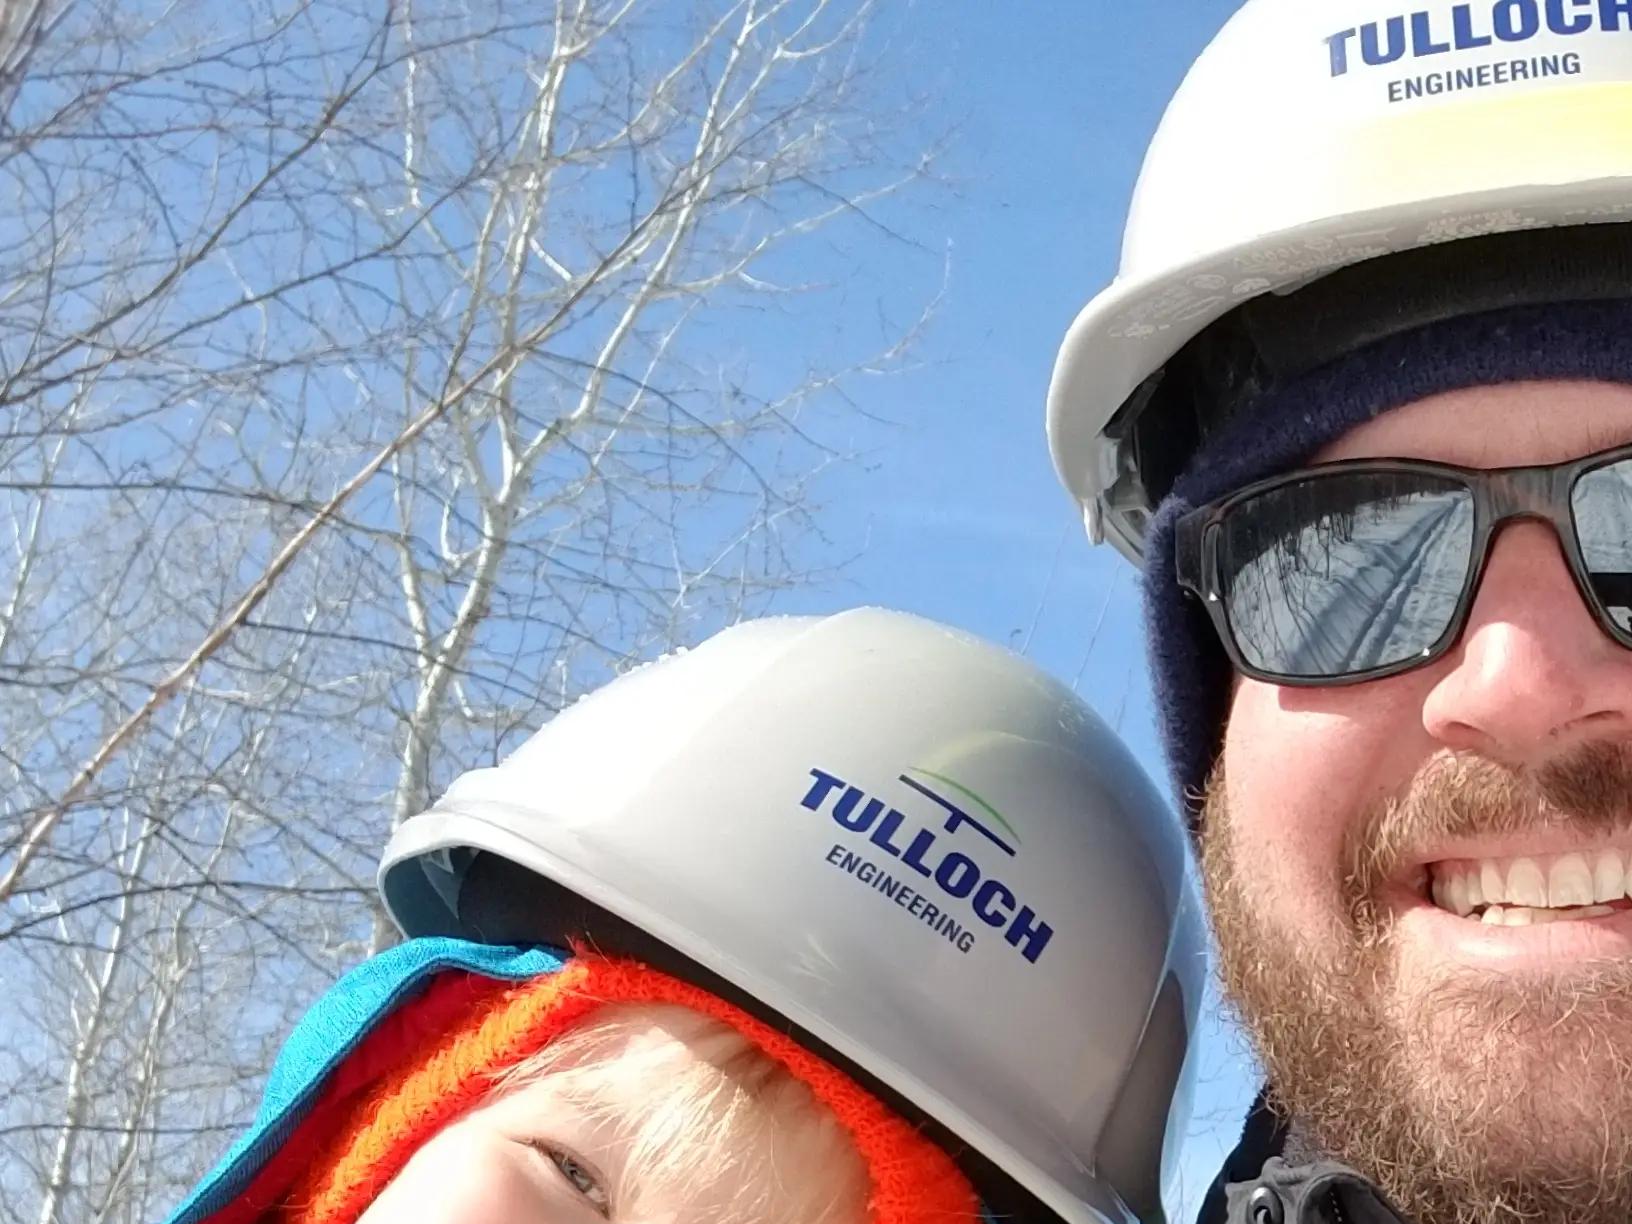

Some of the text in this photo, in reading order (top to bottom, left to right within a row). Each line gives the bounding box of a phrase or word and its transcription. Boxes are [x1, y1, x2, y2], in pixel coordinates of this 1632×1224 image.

[1388, 53, 1582, 102] ENGINEERING
[800, 767, 1054, 964] TULLOCH
[825, 844, 975, 954] ENGINEERING
